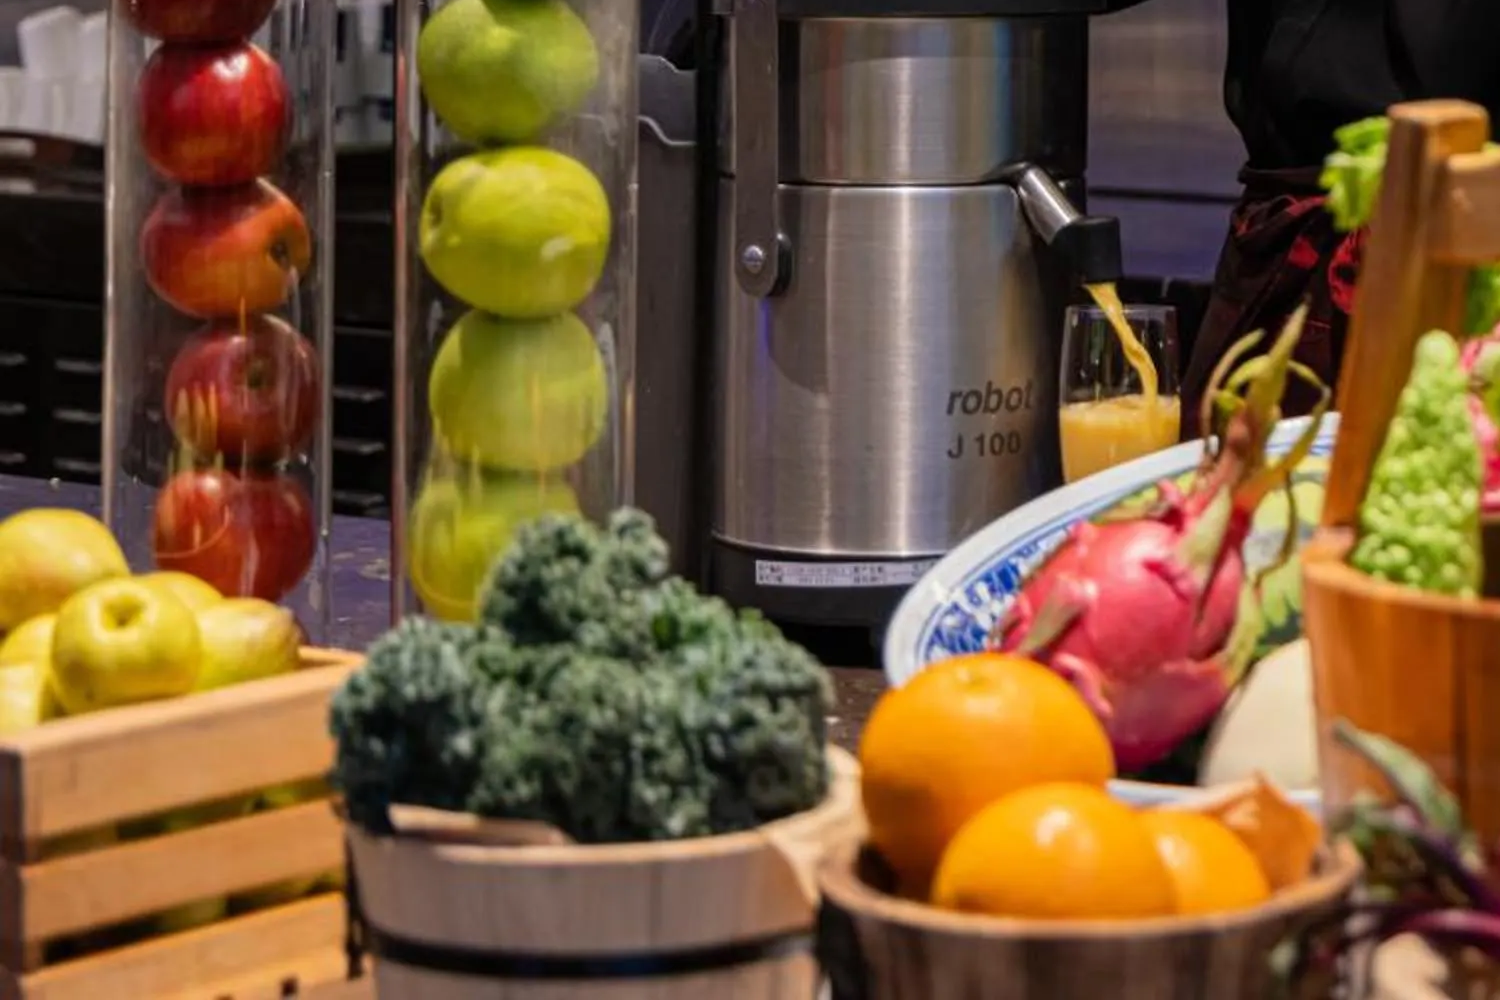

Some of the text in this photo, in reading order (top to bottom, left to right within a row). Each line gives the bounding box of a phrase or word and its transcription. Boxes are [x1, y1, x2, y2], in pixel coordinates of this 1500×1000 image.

[946, 379, 1033, 416] robot
[947, 430, 1021, 459] J 100
